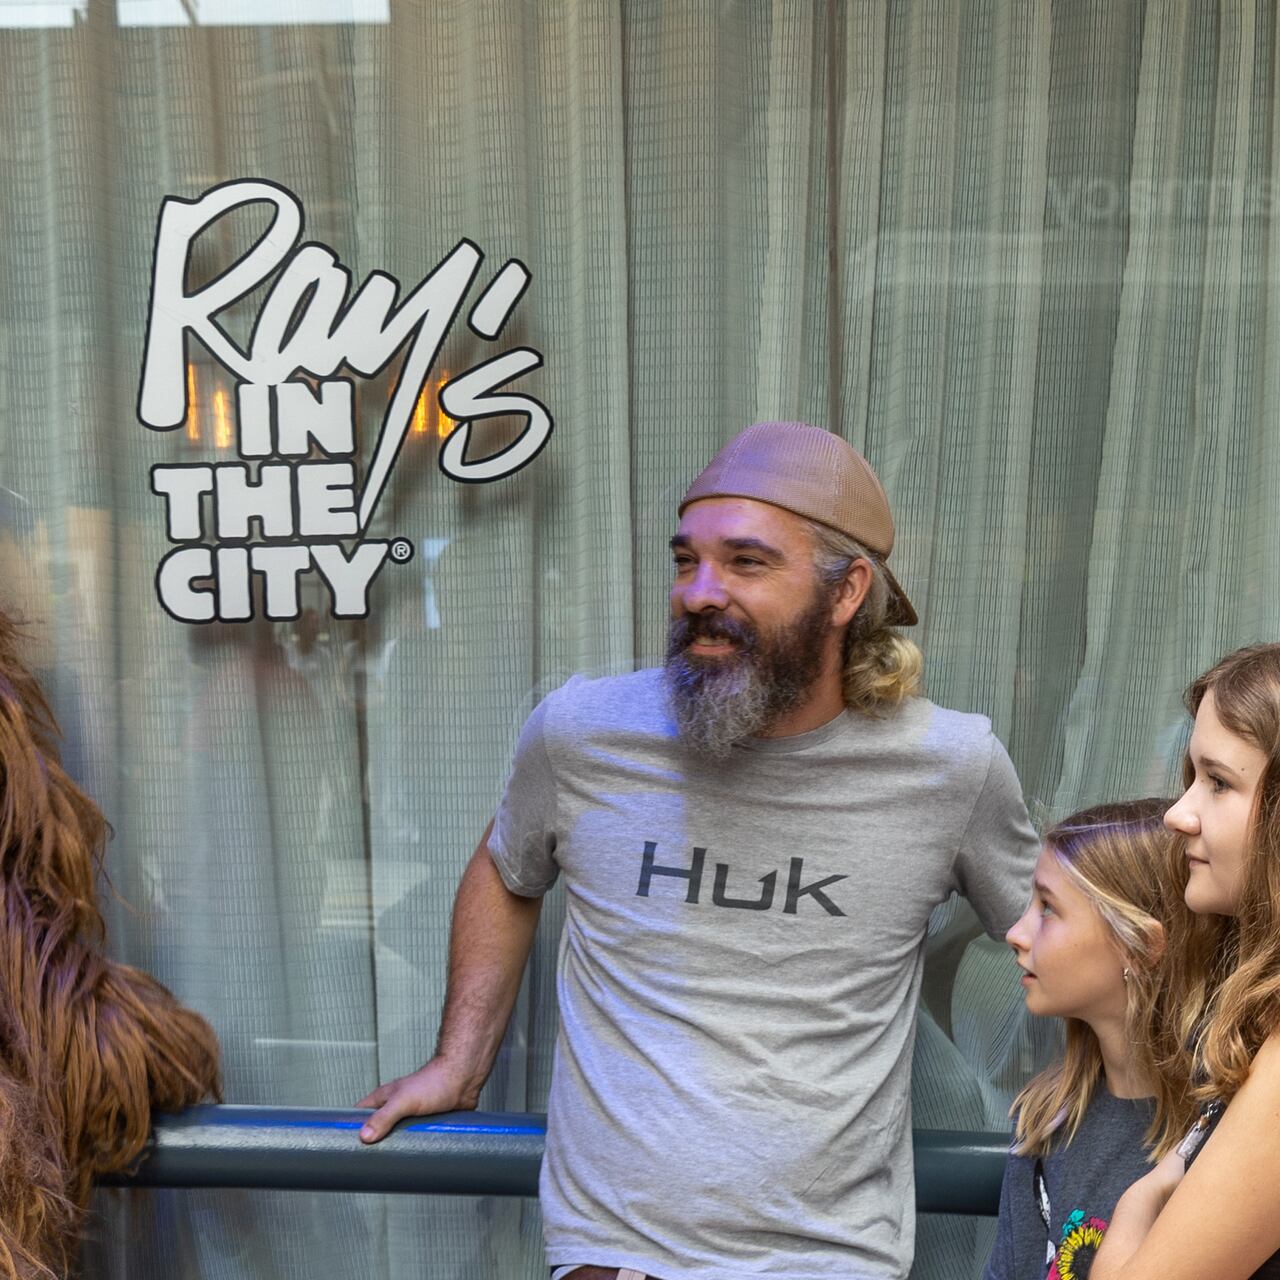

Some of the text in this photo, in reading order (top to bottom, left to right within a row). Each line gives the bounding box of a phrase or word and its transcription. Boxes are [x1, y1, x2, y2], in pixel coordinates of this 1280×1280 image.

[137, 177, 554, 535] Ray's
[235, 376, 357, 459] IN
[151, 460, 360, 543] THE
